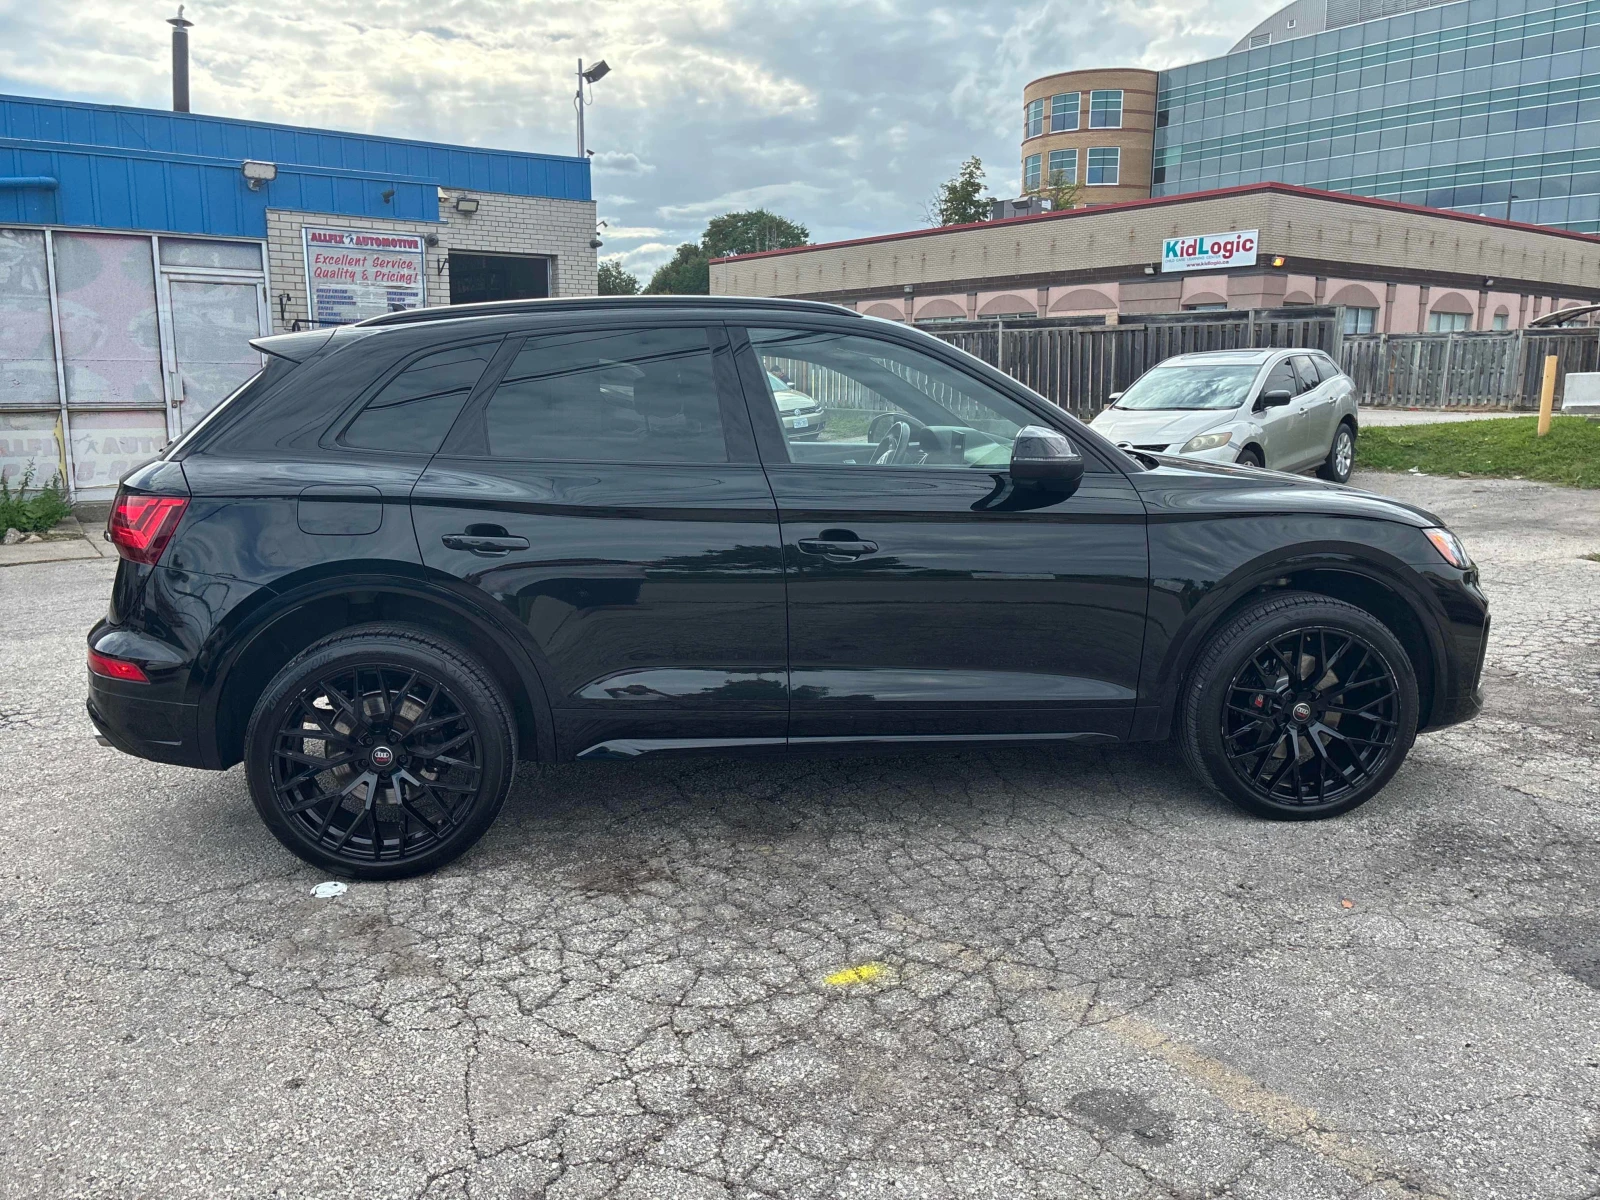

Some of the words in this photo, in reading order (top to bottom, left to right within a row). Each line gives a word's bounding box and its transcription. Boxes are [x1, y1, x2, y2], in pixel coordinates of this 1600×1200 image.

[311, 232, 345, 244] ALLFIX
[355, 235, 420, 250] AUTOMOTIVE
[1165, 234, 1254, 260] KidLogic
[314, 253, 368, 267] Excellent
[372, 257, 417, 271] Service,
[314, 267, 356, 282] Quality
[361, 269, 369, 281] &
[374, 271, 418, 285] Pricing!
